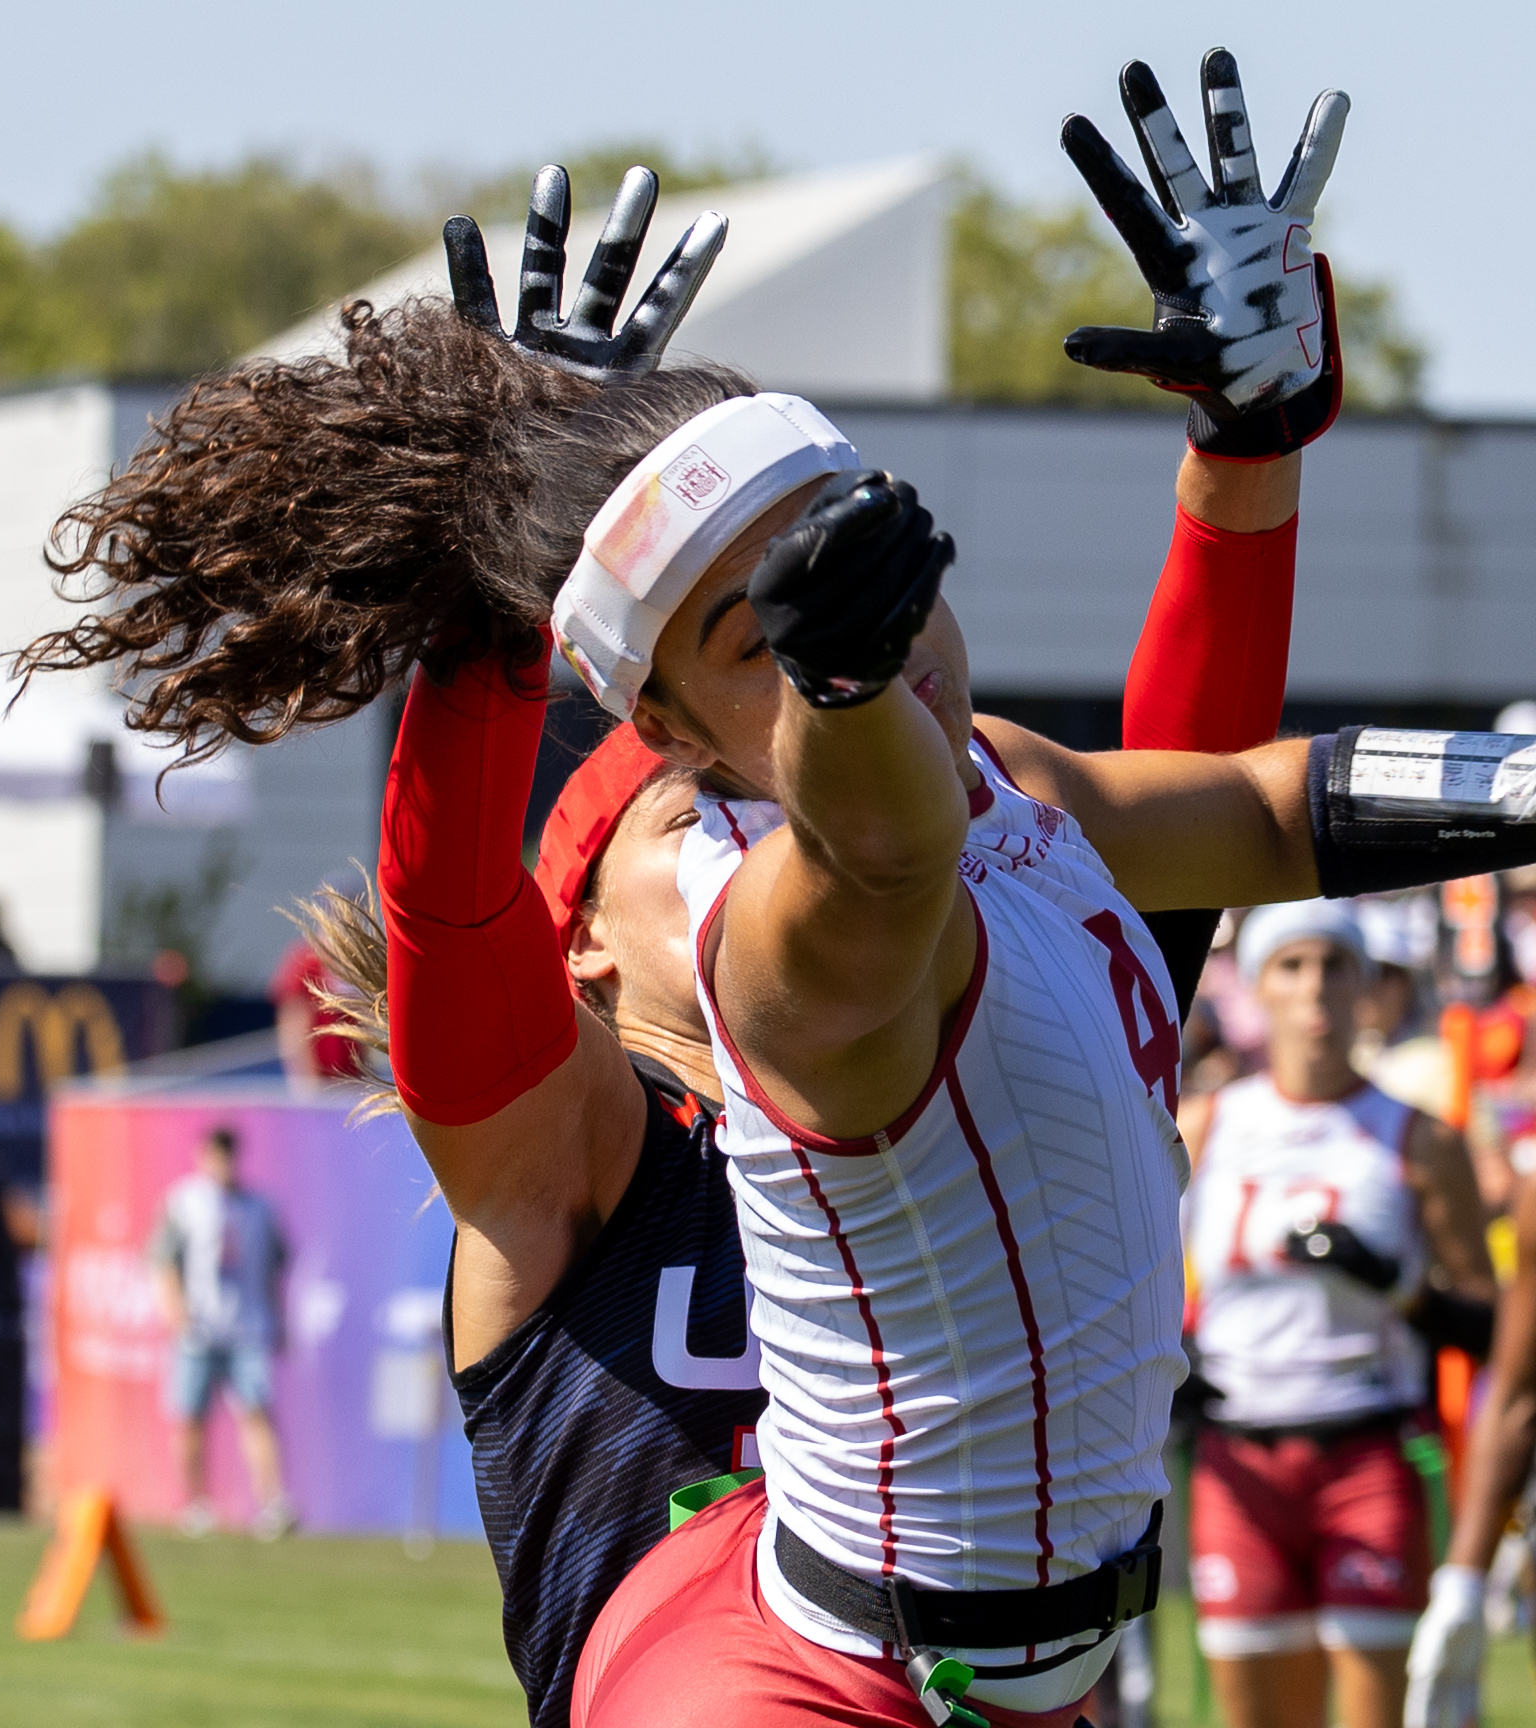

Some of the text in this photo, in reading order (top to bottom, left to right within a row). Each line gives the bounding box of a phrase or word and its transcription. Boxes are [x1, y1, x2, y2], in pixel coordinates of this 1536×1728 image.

[662, 450, 698, 481] ESPAÑA
[1438, 825, 1496, 839] Epic Sports
